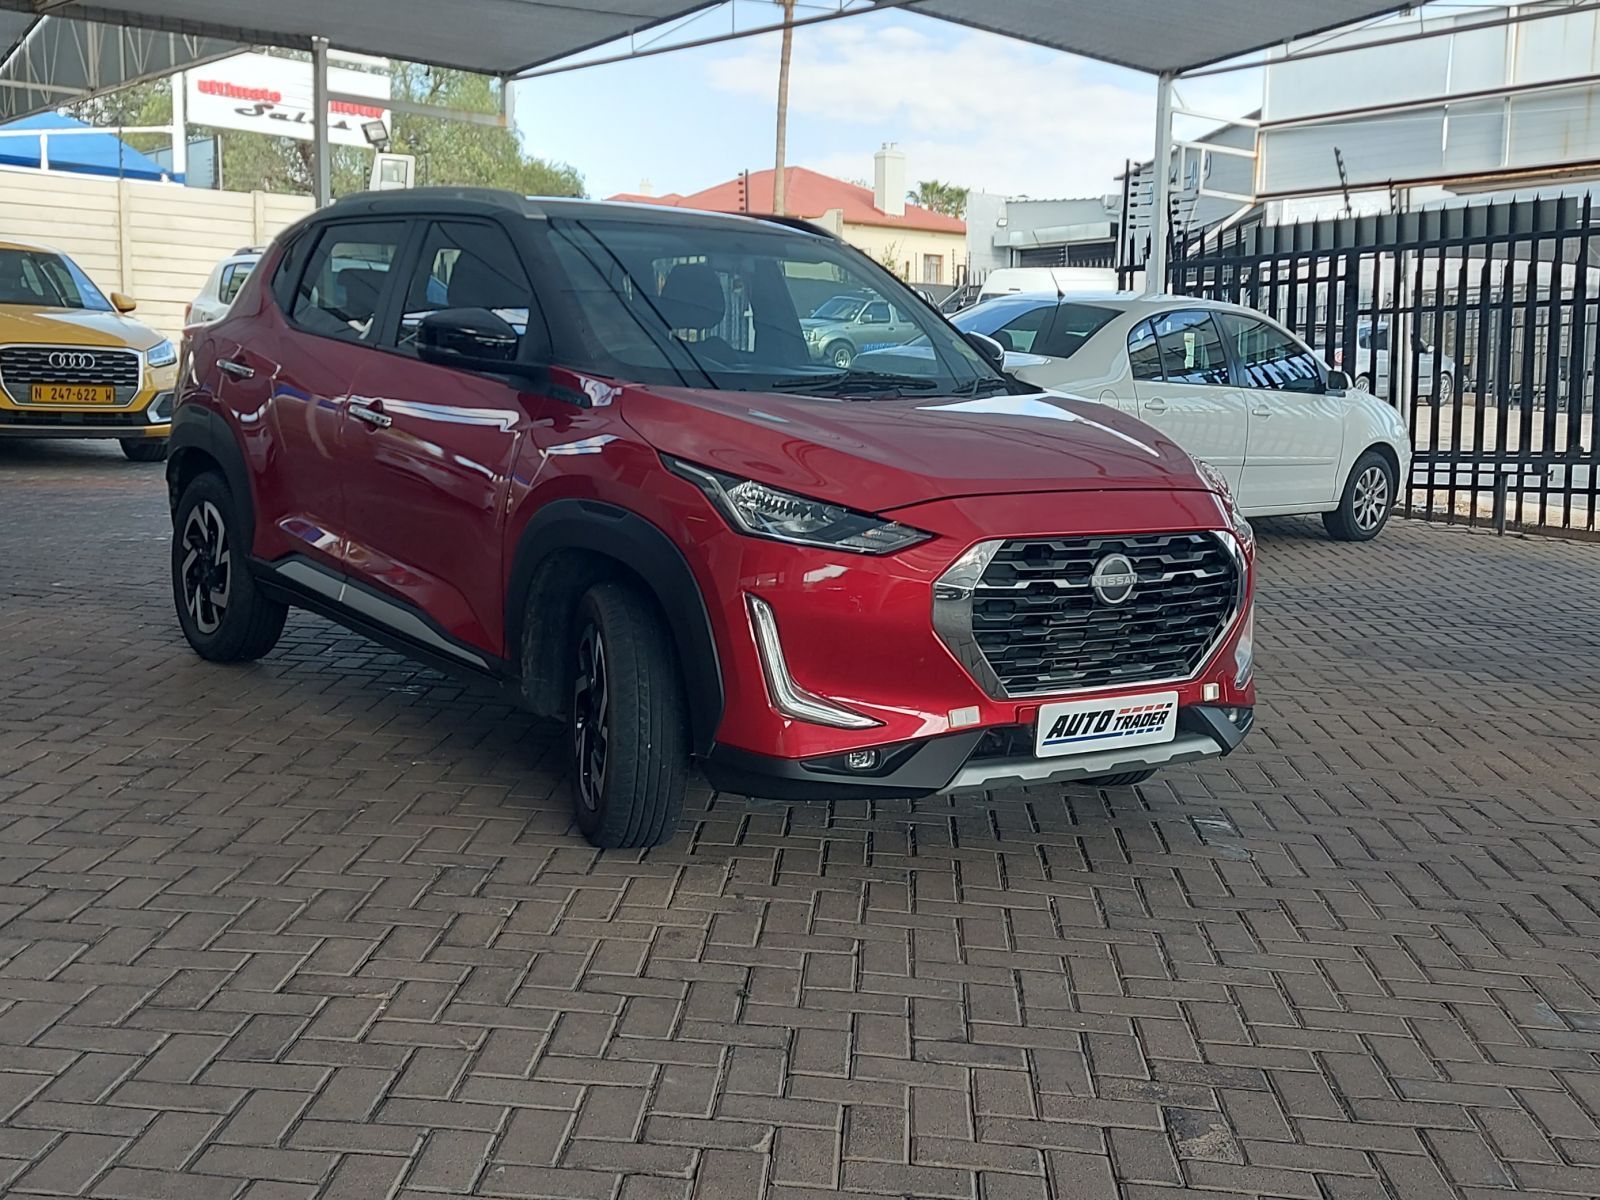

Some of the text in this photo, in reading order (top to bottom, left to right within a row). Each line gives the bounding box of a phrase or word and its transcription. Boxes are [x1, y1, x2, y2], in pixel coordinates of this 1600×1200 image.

[233, 102, 352, 130] Sals
[34, 388, 112, 401] N 247-622 W
[1093, 574, 1137, 586] NISSAN
[1045, 709, 1171, 739] AUTO TRADER
